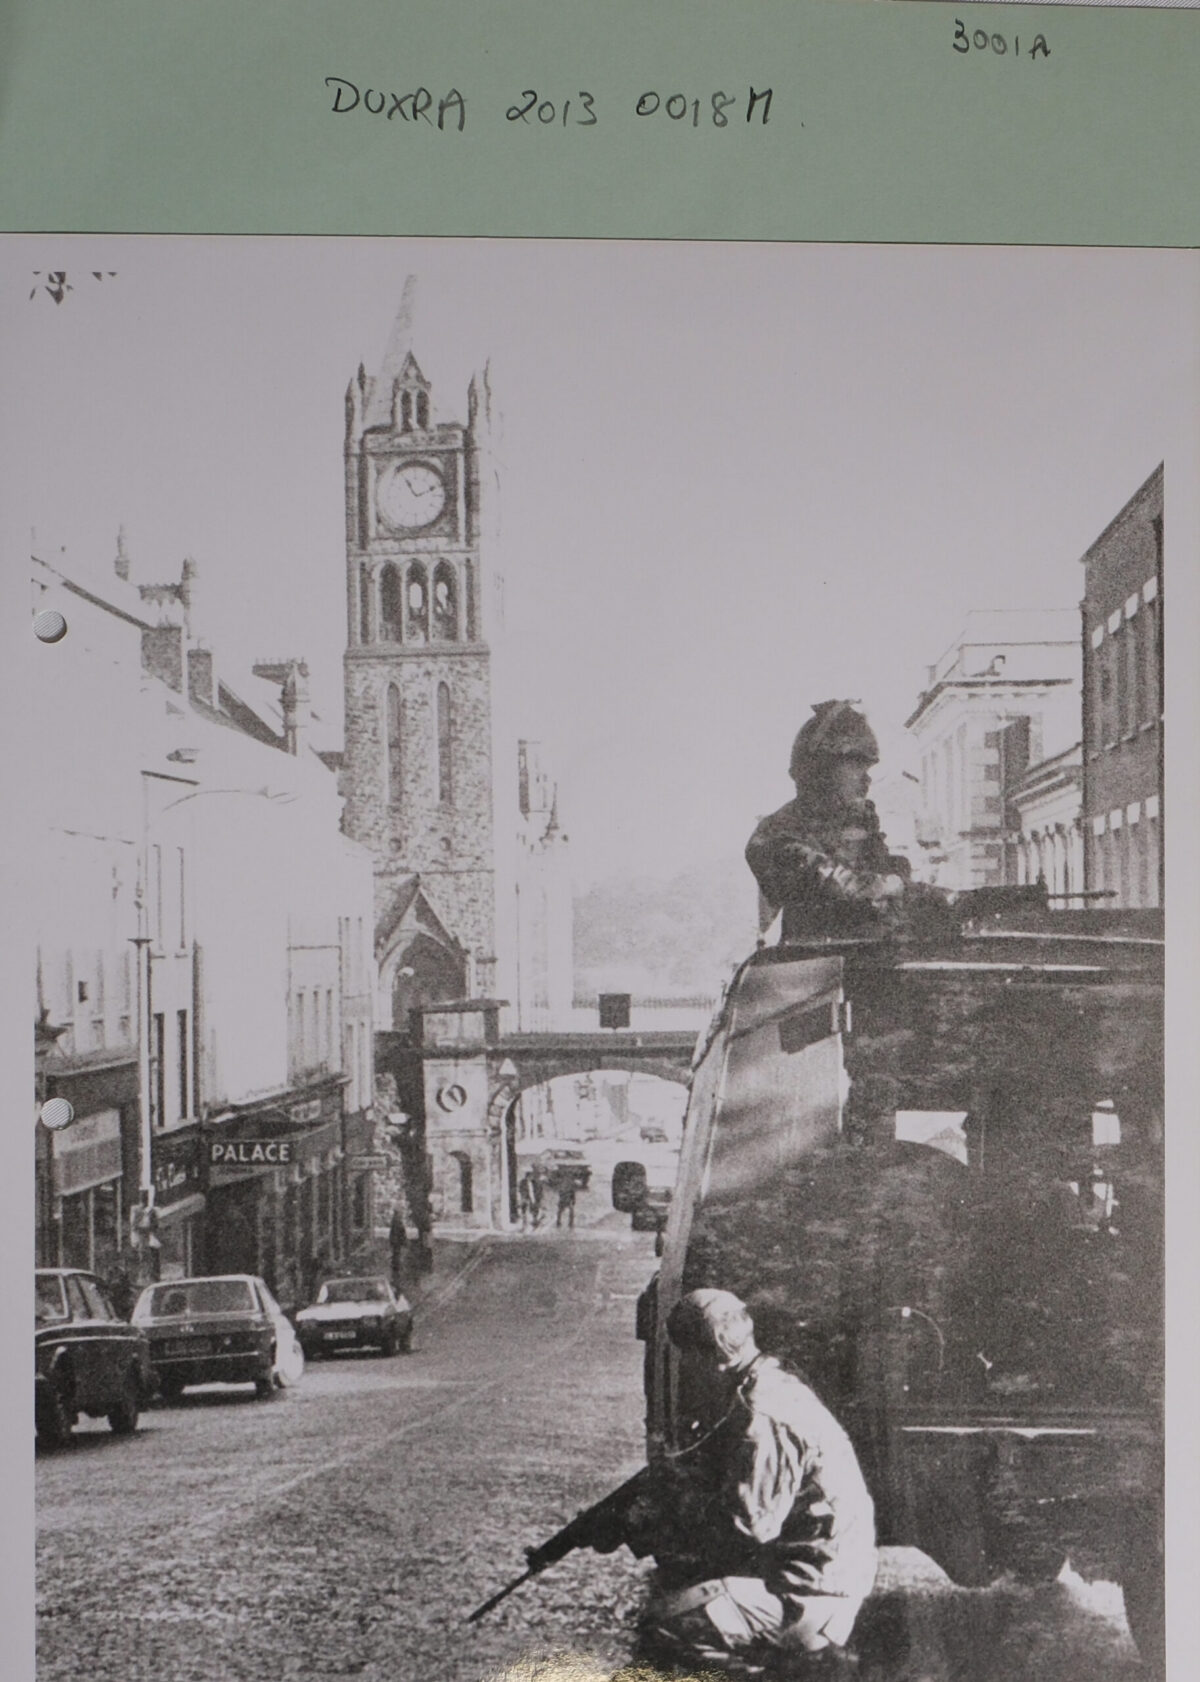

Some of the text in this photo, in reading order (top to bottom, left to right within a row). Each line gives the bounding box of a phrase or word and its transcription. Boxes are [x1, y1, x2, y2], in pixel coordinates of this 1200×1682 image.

[952, 18, 1052, 60] 3001A
[505, 89, 598, 127] 2013
[211, 1143, 290, 1162] PALACE
